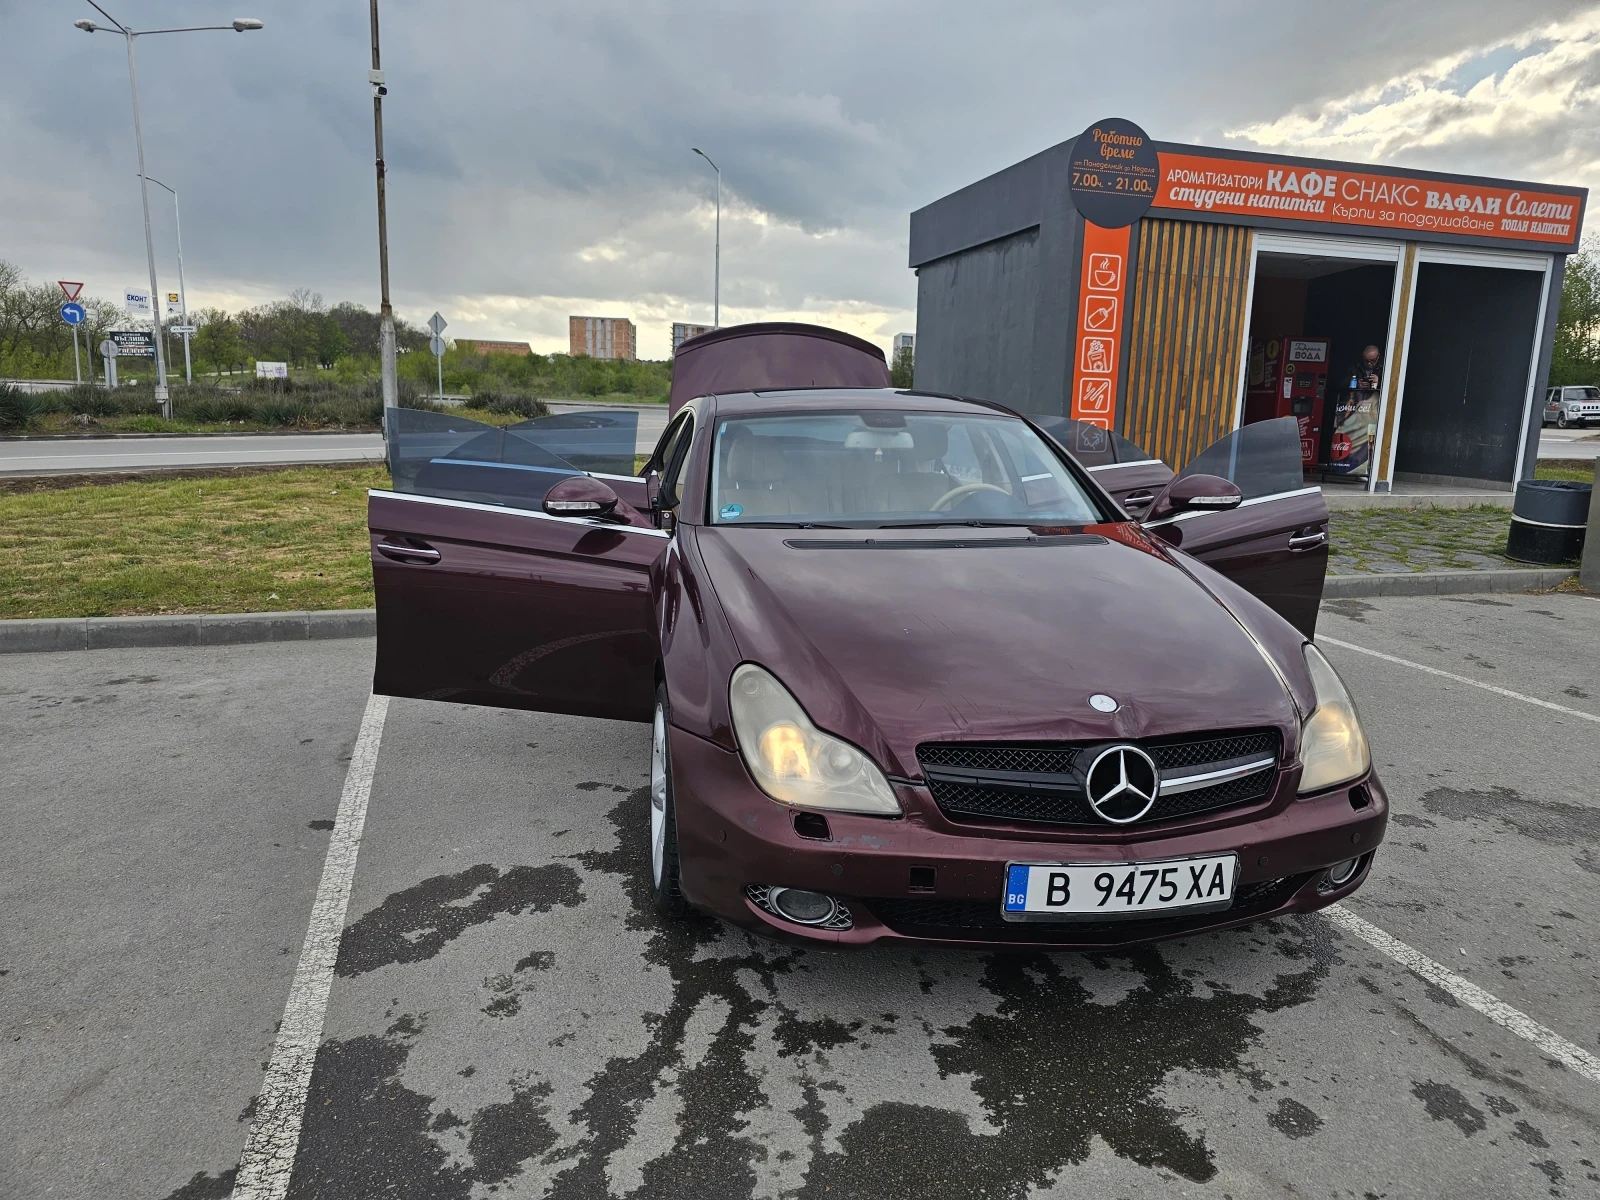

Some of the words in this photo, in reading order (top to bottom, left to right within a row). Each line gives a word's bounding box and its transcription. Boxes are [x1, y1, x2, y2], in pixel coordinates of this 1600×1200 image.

[1093, 128, 1143, 147] Работно
[1100, 143, 1135, 160] време
[1083, 159, 1123, 170] Понеделник
[1131, 164, 1155, 174] Неделя
[1072, 172, 1104, 188] 7.00ч.
[1115, 177, 1154, 193] 21.00ч.
[1167, 168, 1263, 190] АРОМАТИЗАТОРИ
[1266, 169, 1338, 198] КАФЕ
[1342, 178, 1420, 207] СНАКС
[1424, 190, 1502, 215] ВАФЛИ
[1506, 192, 1574, 220] Солети
[1169, 186, 1246, 209] студени
[1247, 193, 1326, 213] напитки
[1332, 203, 1376, 220] Кърпи
[1378, 210, 1396, 221] за
[1399, 211, 1495, 232] подсушаване
[1501, 218, 1529, 233] ТОПЛИ
[1530, 221, 1570, 236] НАПИТКИ
[126, 294, 148, 303] ЕКОНТ
[1294, 351, 1321, 360] ВОДА
[1046, 872, 1071, 906] B
[1094, 867, 1178, 907] 9475
[1185, 862, 1225, 900] XA
[1008, 893, 1025, 905] BG
